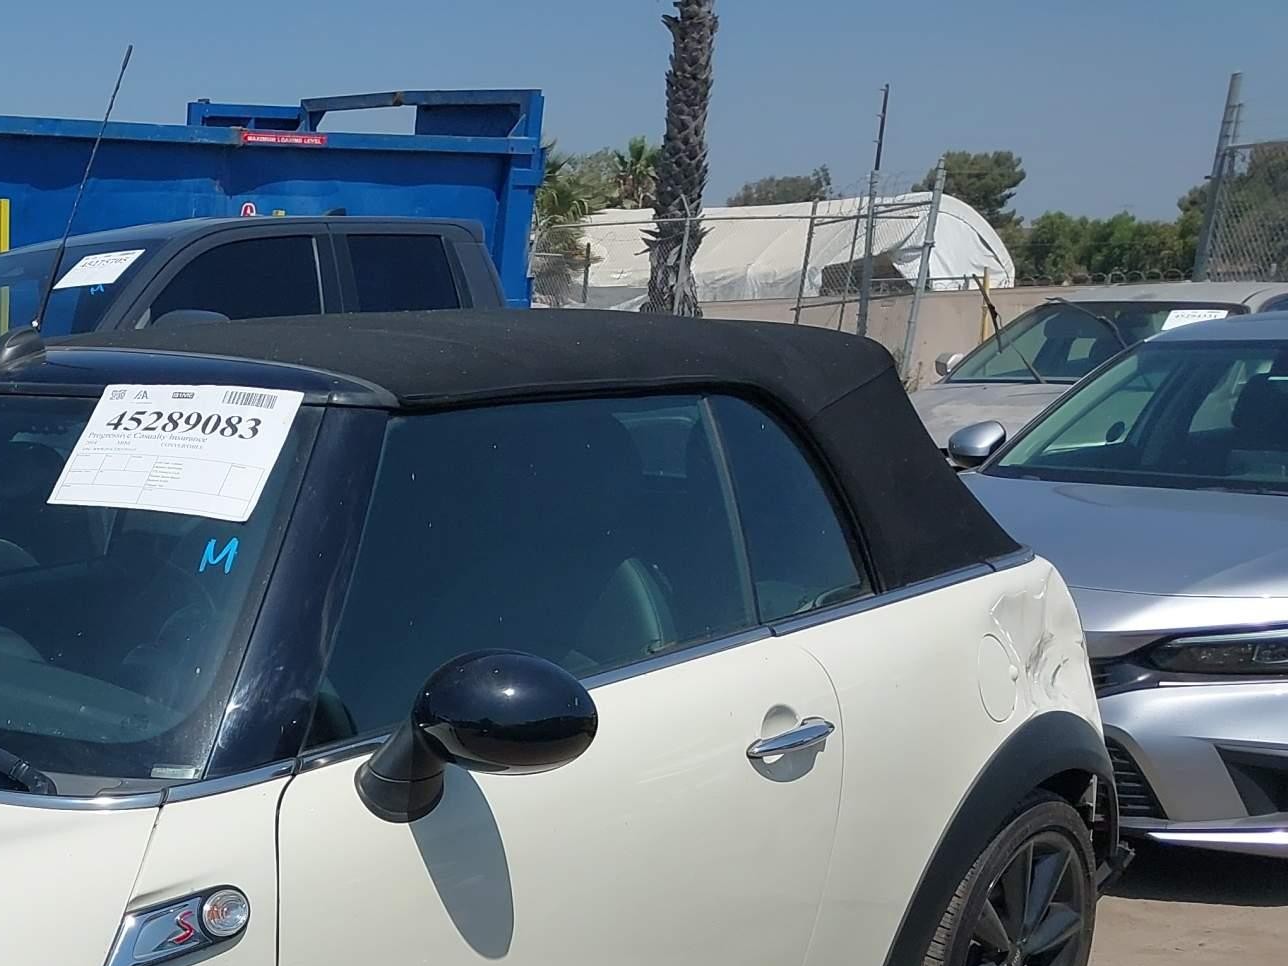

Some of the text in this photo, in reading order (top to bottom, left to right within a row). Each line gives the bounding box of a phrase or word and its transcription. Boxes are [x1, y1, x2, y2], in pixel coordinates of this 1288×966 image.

[303, 137, 322, 145] LEVEL
[88, 431, 208, 443] Progressive Casualty Insurance
[106, 410, 263, 440] 45289083
[199, 536, 240, 575] M
[168, 911, 195, 945] S
